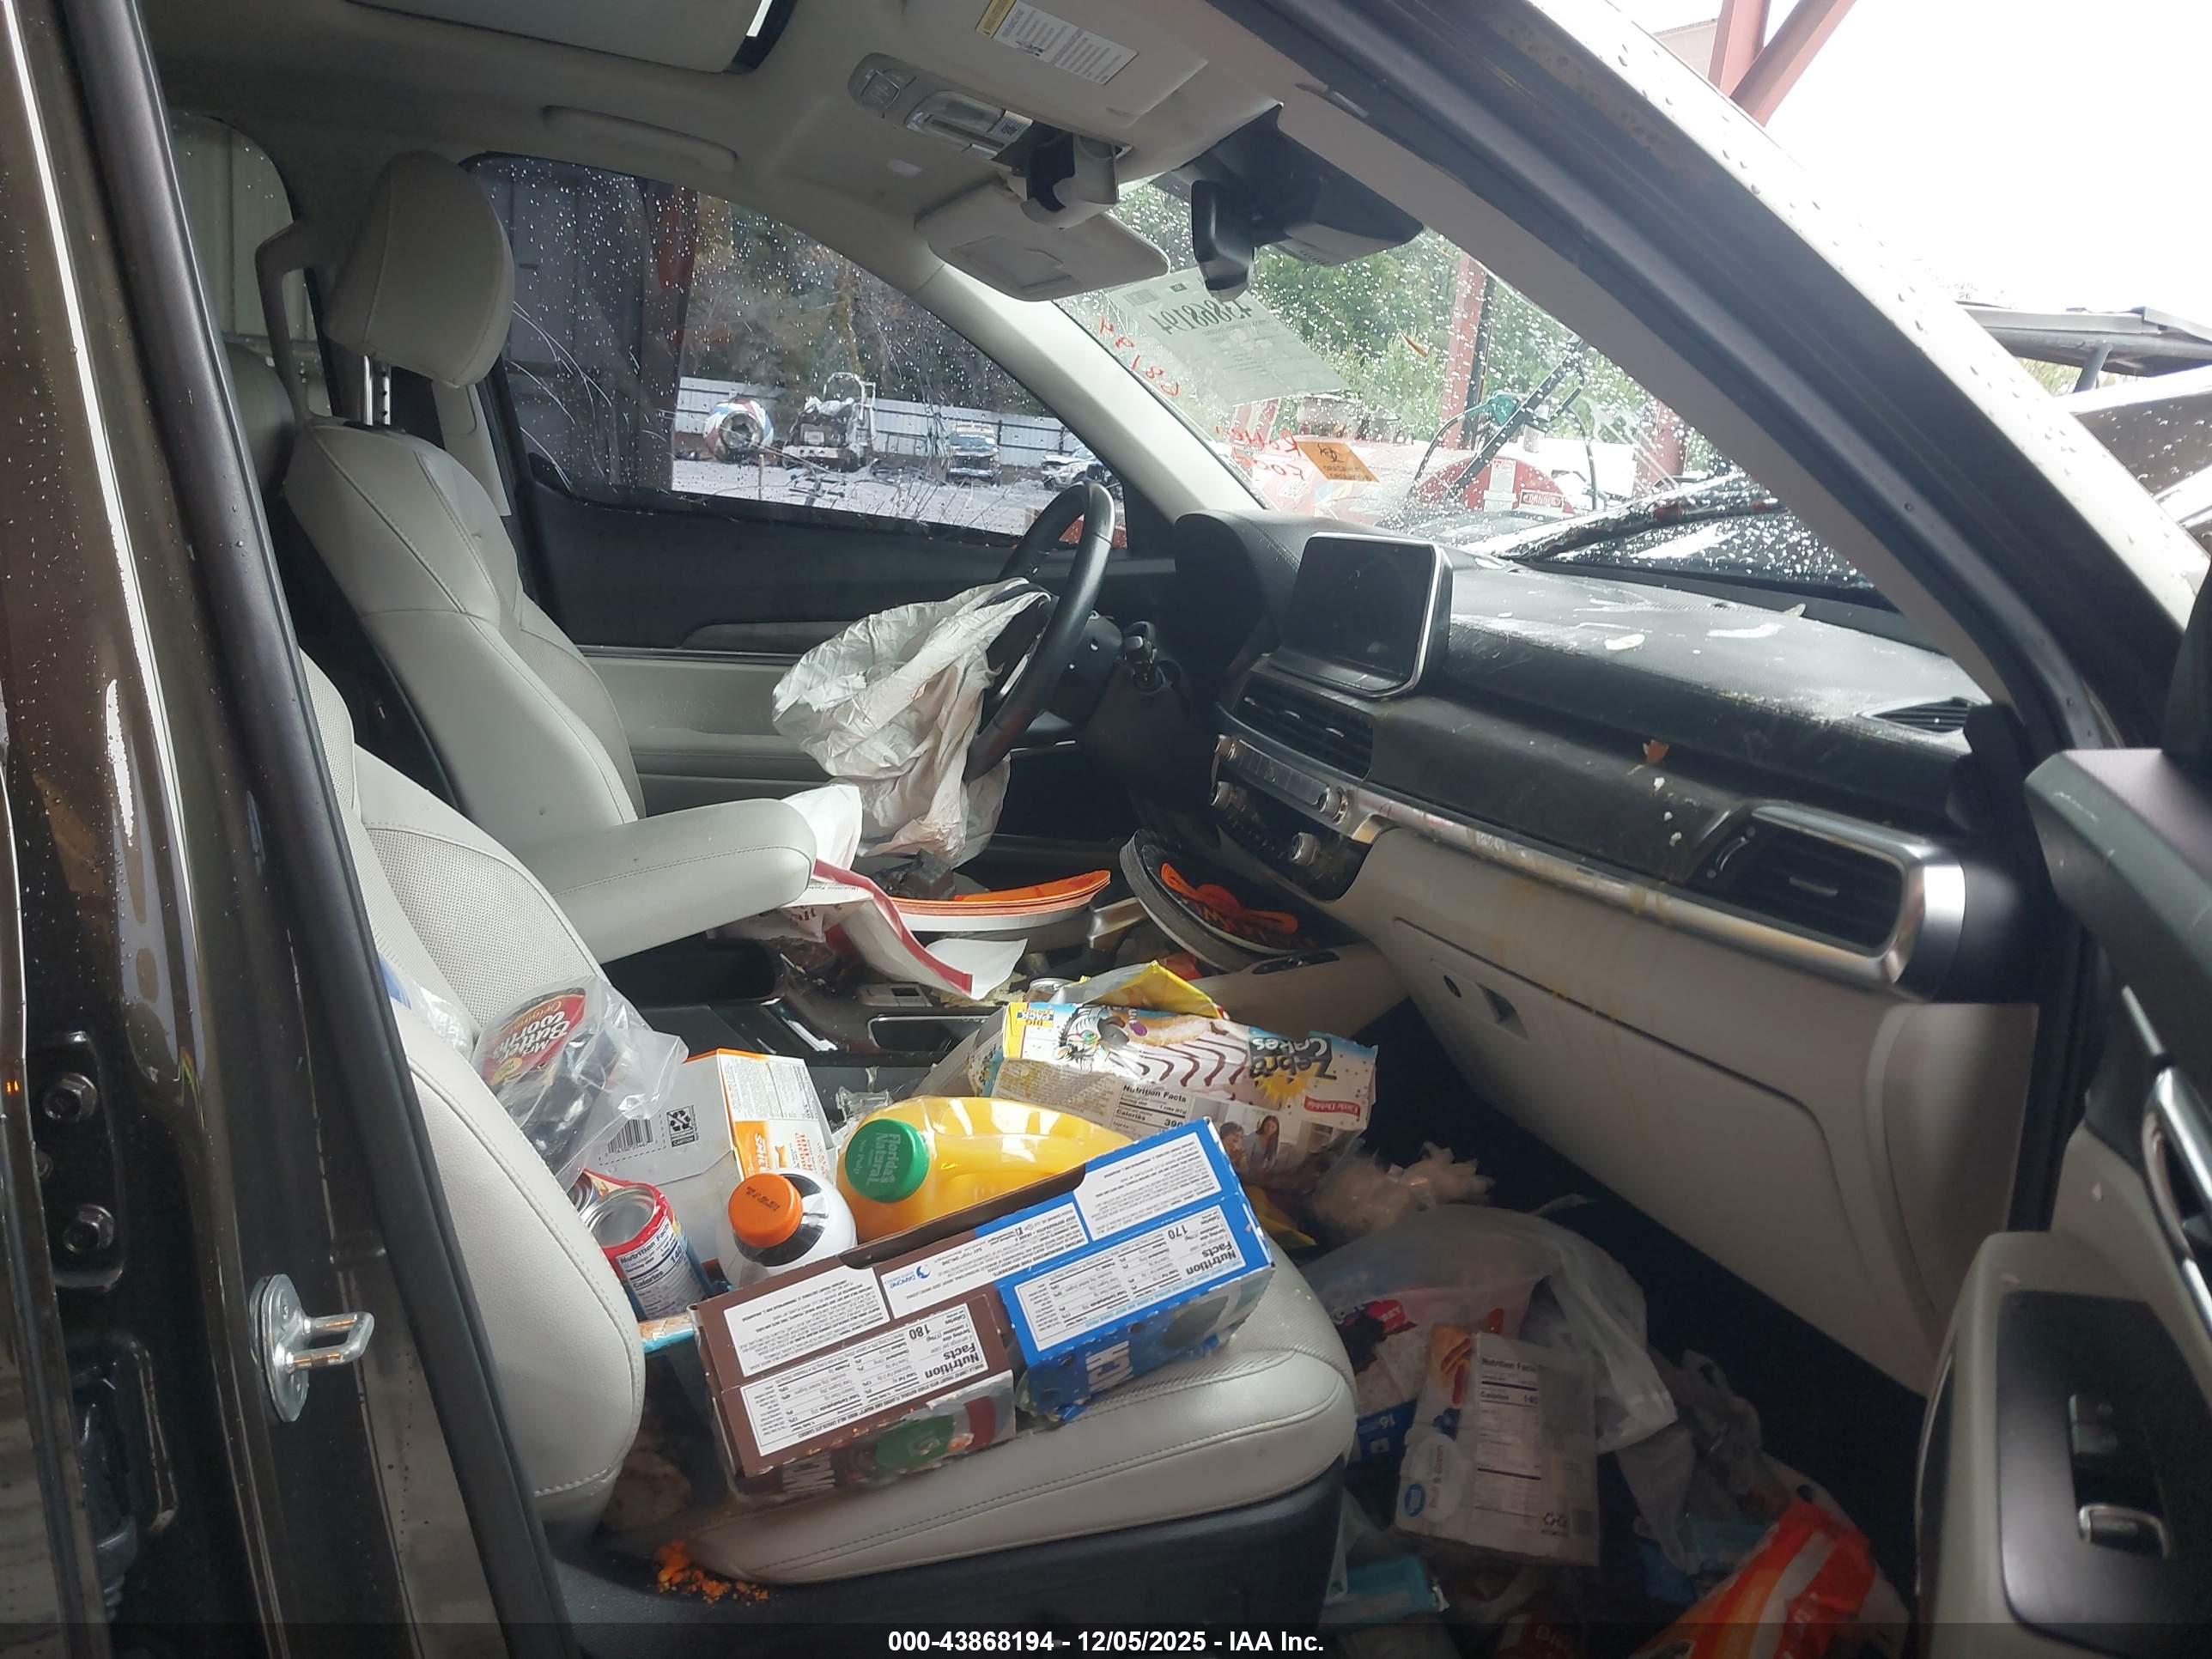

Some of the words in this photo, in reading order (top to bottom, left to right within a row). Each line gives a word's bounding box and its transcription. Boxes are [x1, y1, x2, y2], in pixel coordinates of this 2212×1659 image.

[1250, 1032, 1328, 1056] Cakes
[1249, 1053, 1337, 1084] Zebra
[1122, 1084, 1161, 1097] Nutrition
[1163, 1091, 1187, 1102] Facts
[1115, 1109, 1146, 1121] Calories
[1166, 1224, 1188, 1239] 170
[617, 1241, 658, 1264] Nutrition
[1200, 1240, 1232, 1259] Facts
[1184, 1249, 1237, 1276] Nutrition
[631, 1270, 665, 1288] Calories
[945, 1313, 965, 1326] Calories
[908, 1323, 930, 1340] 180
[942, 1341, 976, 1362] Facts
[923, 1351, 979, 1381] Nutrition
